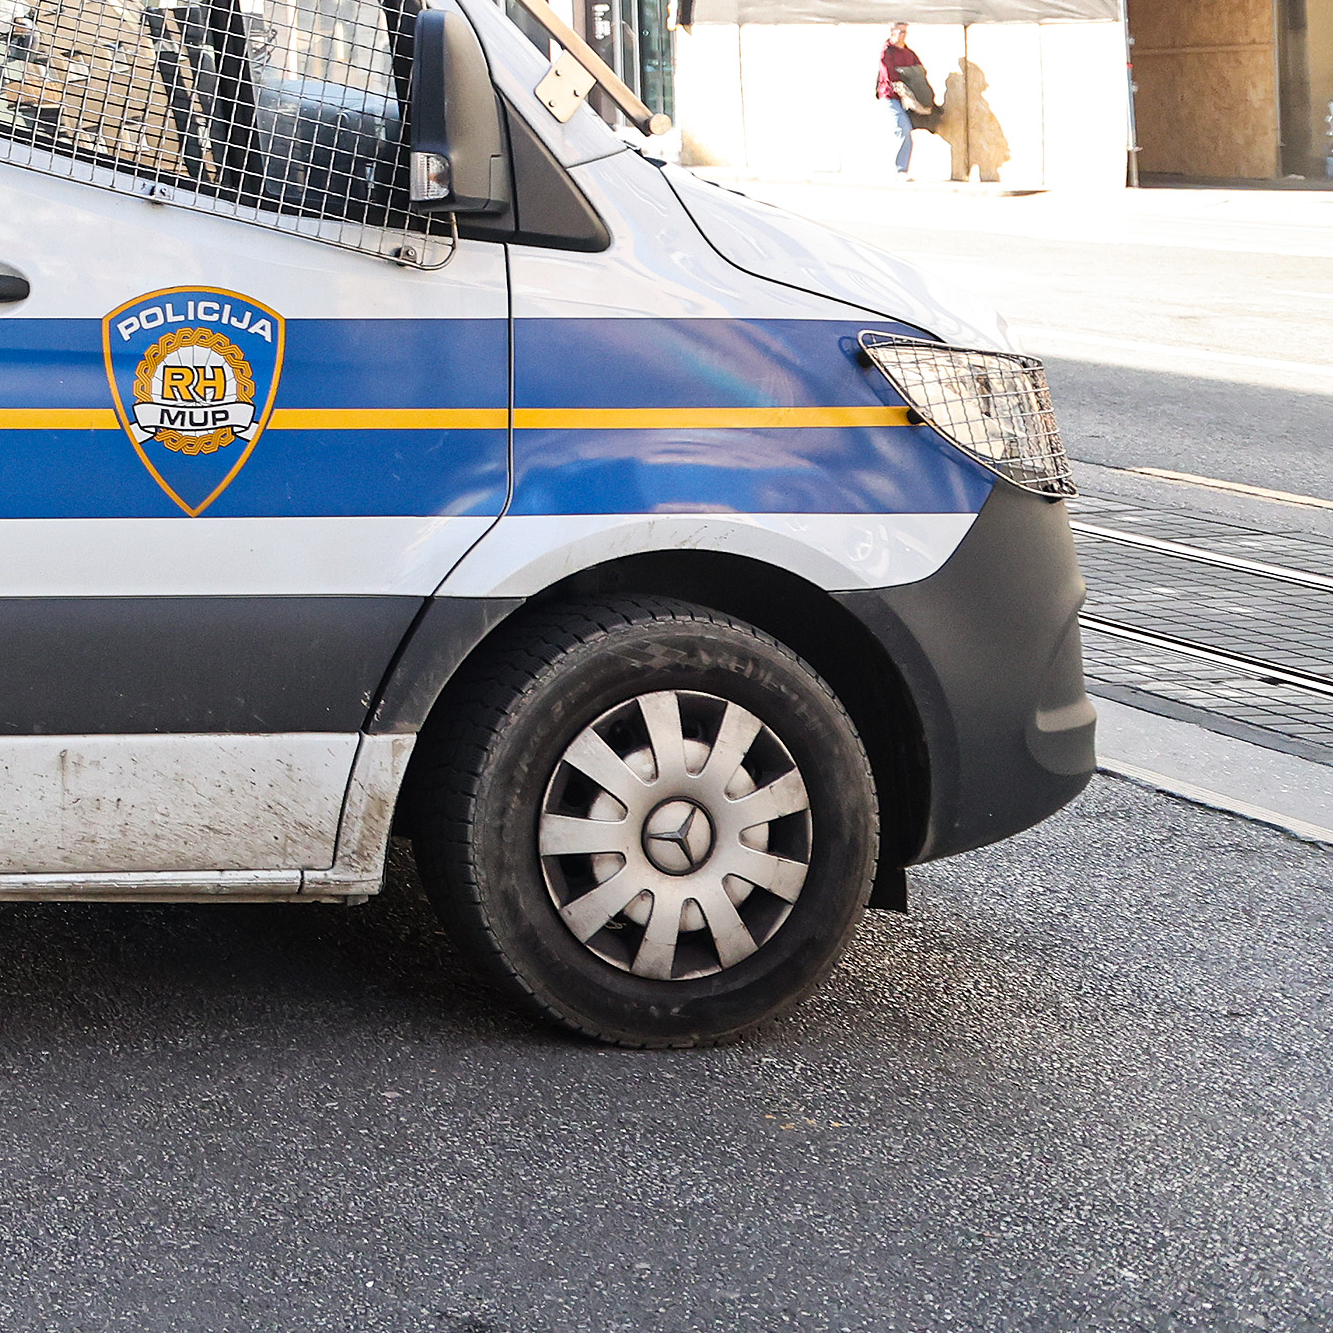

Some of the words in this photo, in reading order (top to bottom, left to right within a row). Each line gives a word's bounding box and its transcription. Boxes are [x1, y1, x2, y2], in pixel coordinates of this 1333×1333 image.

[116, 300, 273, 343] POLICIJA
[162, 365, 227, 402] RH
[159, 408, 230, 427] MUP
